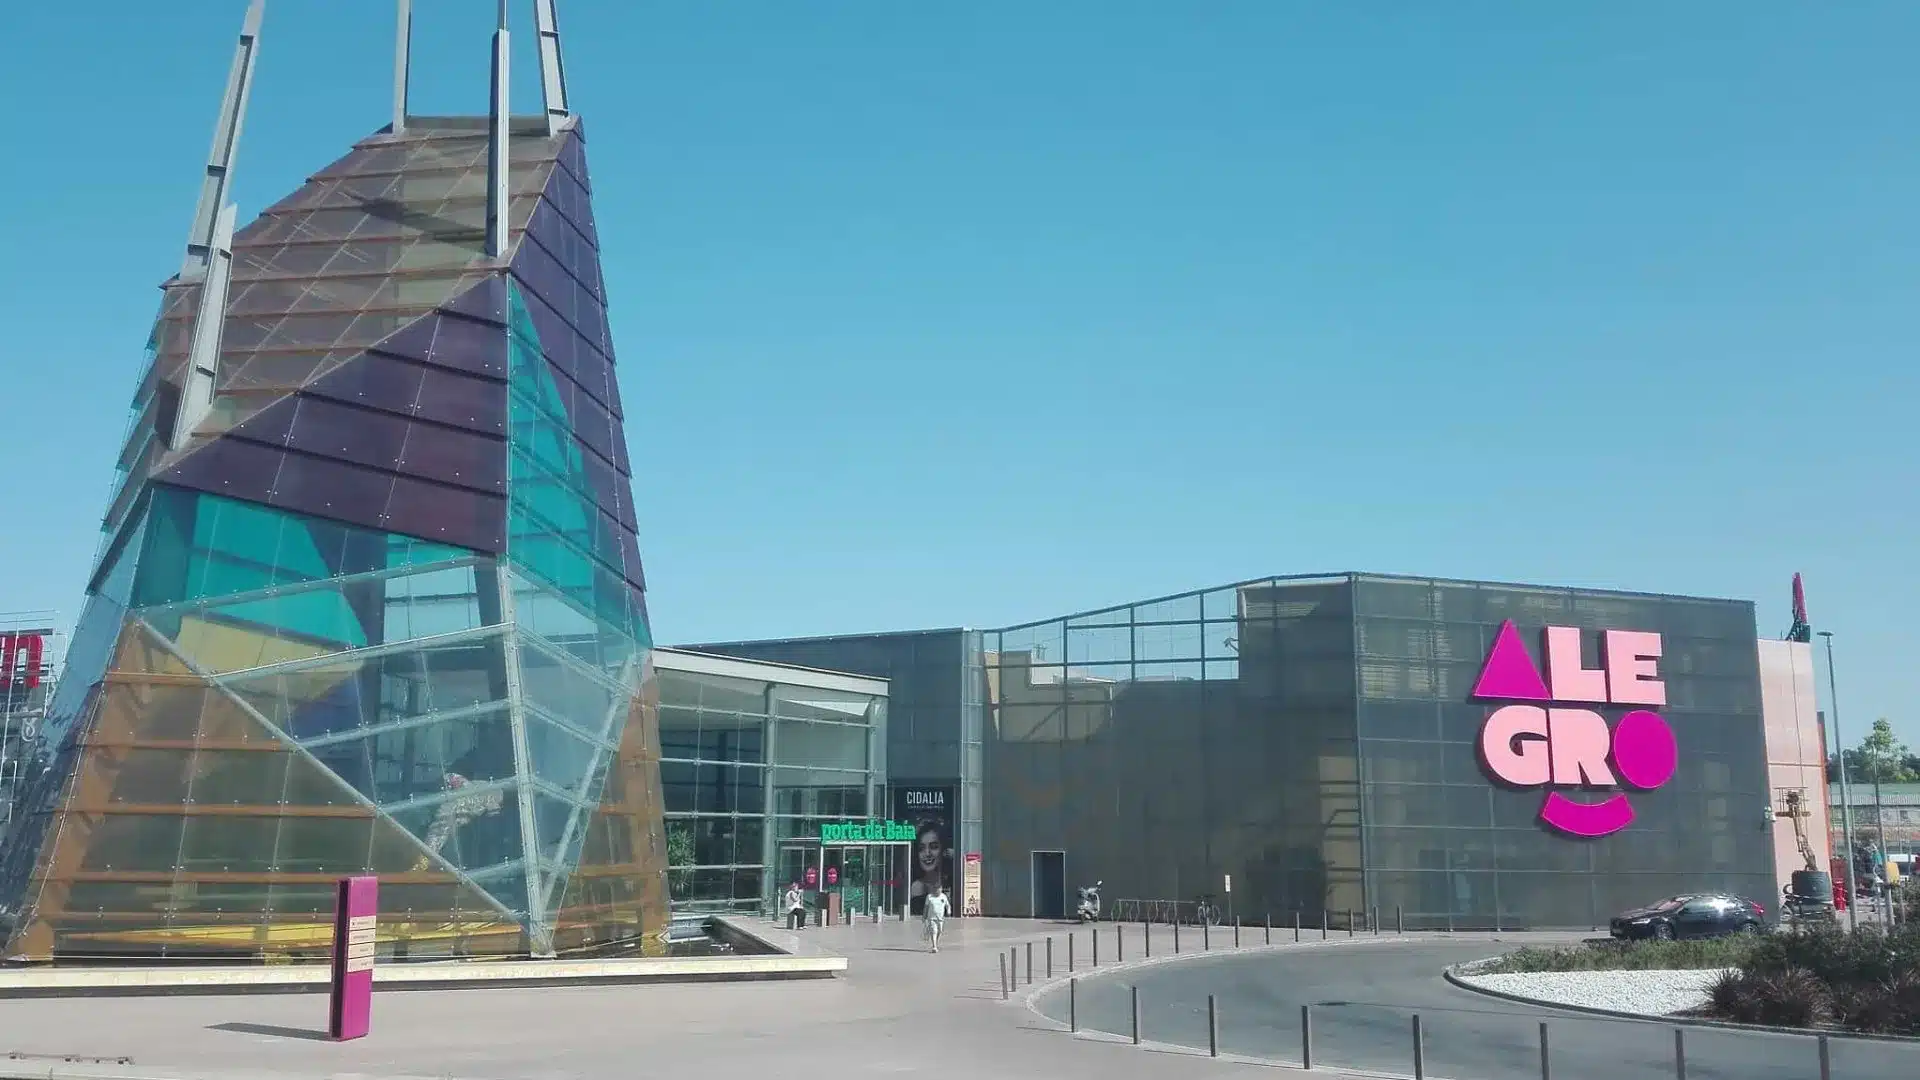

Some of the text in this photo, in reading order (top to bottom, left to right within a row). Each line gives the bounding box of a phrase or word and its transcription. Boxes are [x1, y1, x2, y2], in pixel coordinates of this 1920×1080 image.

[1473, 618, 1666, 705] ALE
[1482, 705, 1677, 788] GRO
[906, 791, 944, 804] CIDALIA
[821, 820, 862, 845] porta
[865, 818, 884, 840] da
